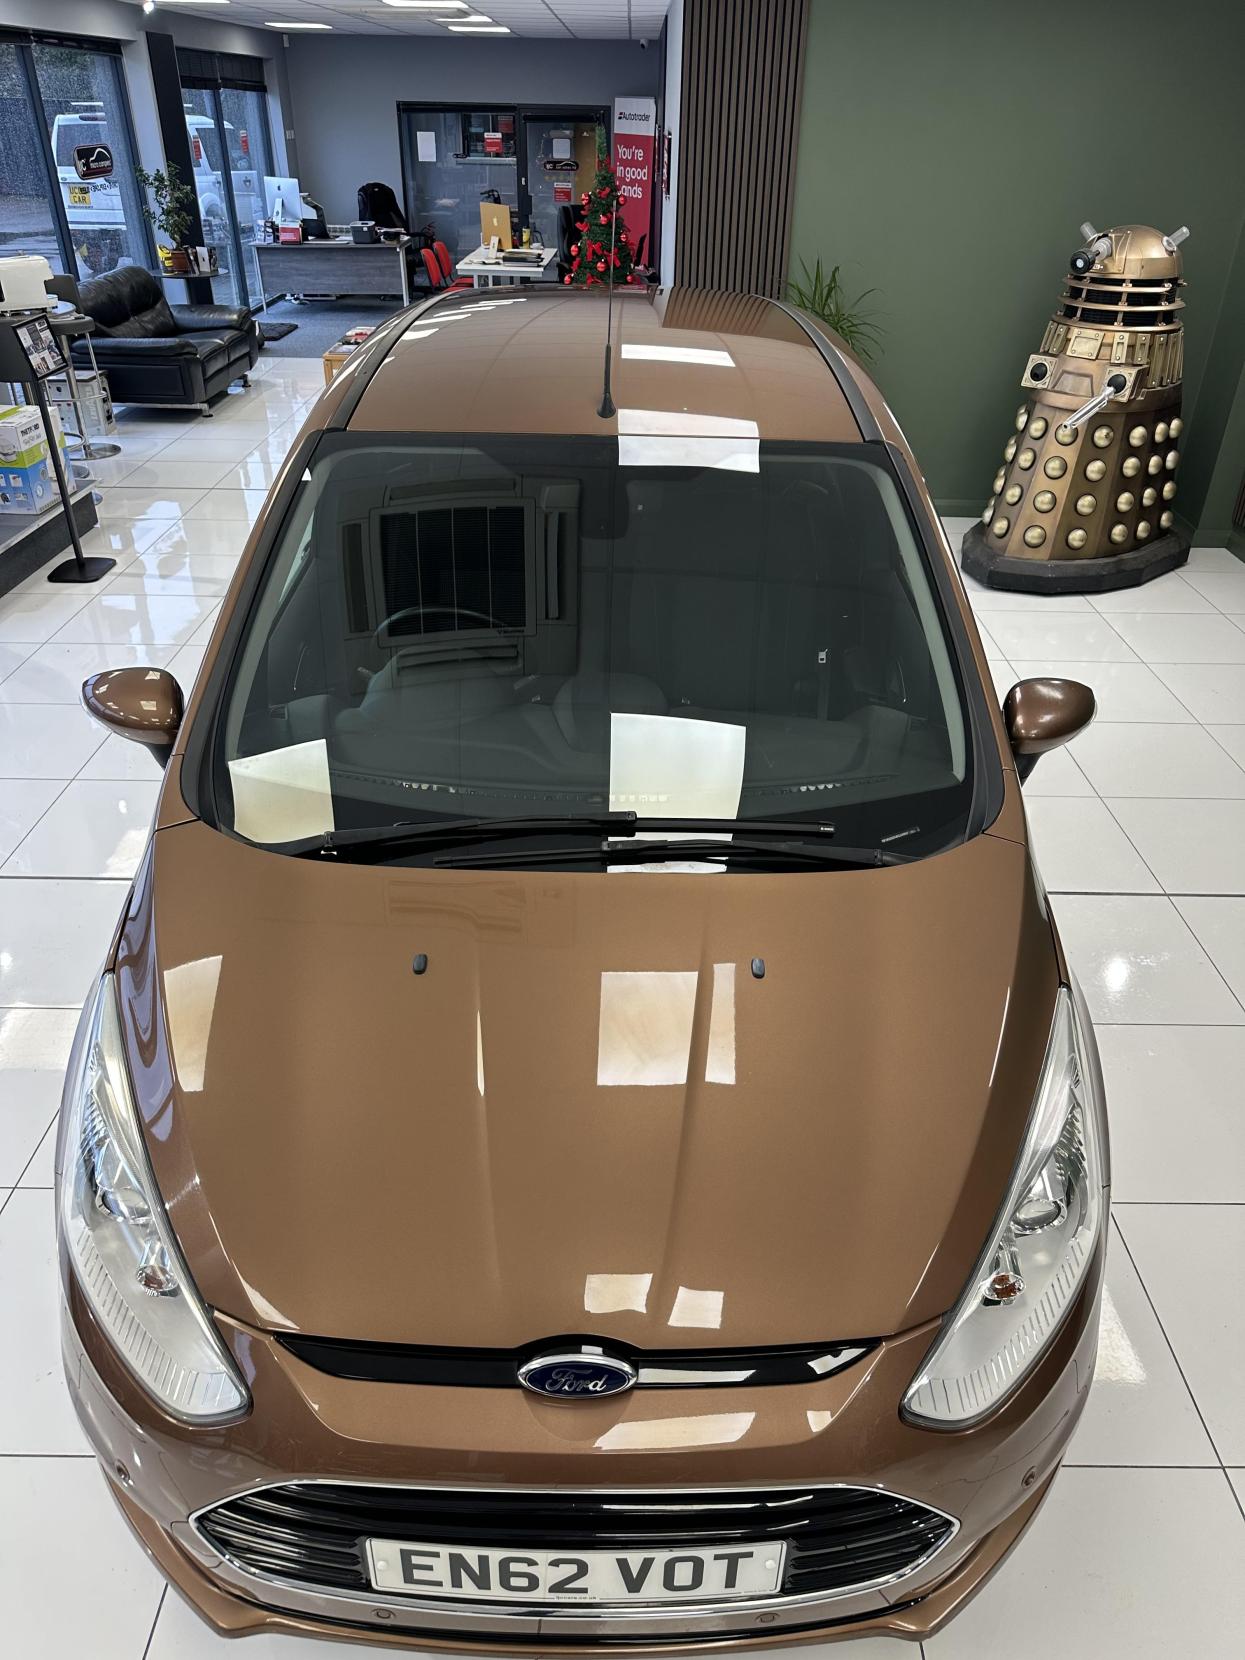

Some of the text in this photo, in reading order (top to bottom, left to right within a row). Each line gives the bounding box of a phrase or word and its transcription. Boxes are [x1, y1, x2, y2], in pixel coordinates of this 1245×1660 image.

[622, 112, 650, 121] Autotrader
[617, 144, 643, 160] You're
[616, 162, 648, 181] in good
[545, 1368, 609, 1392] Ford
[399, 1548, 754, 1594] EN62 VOT
